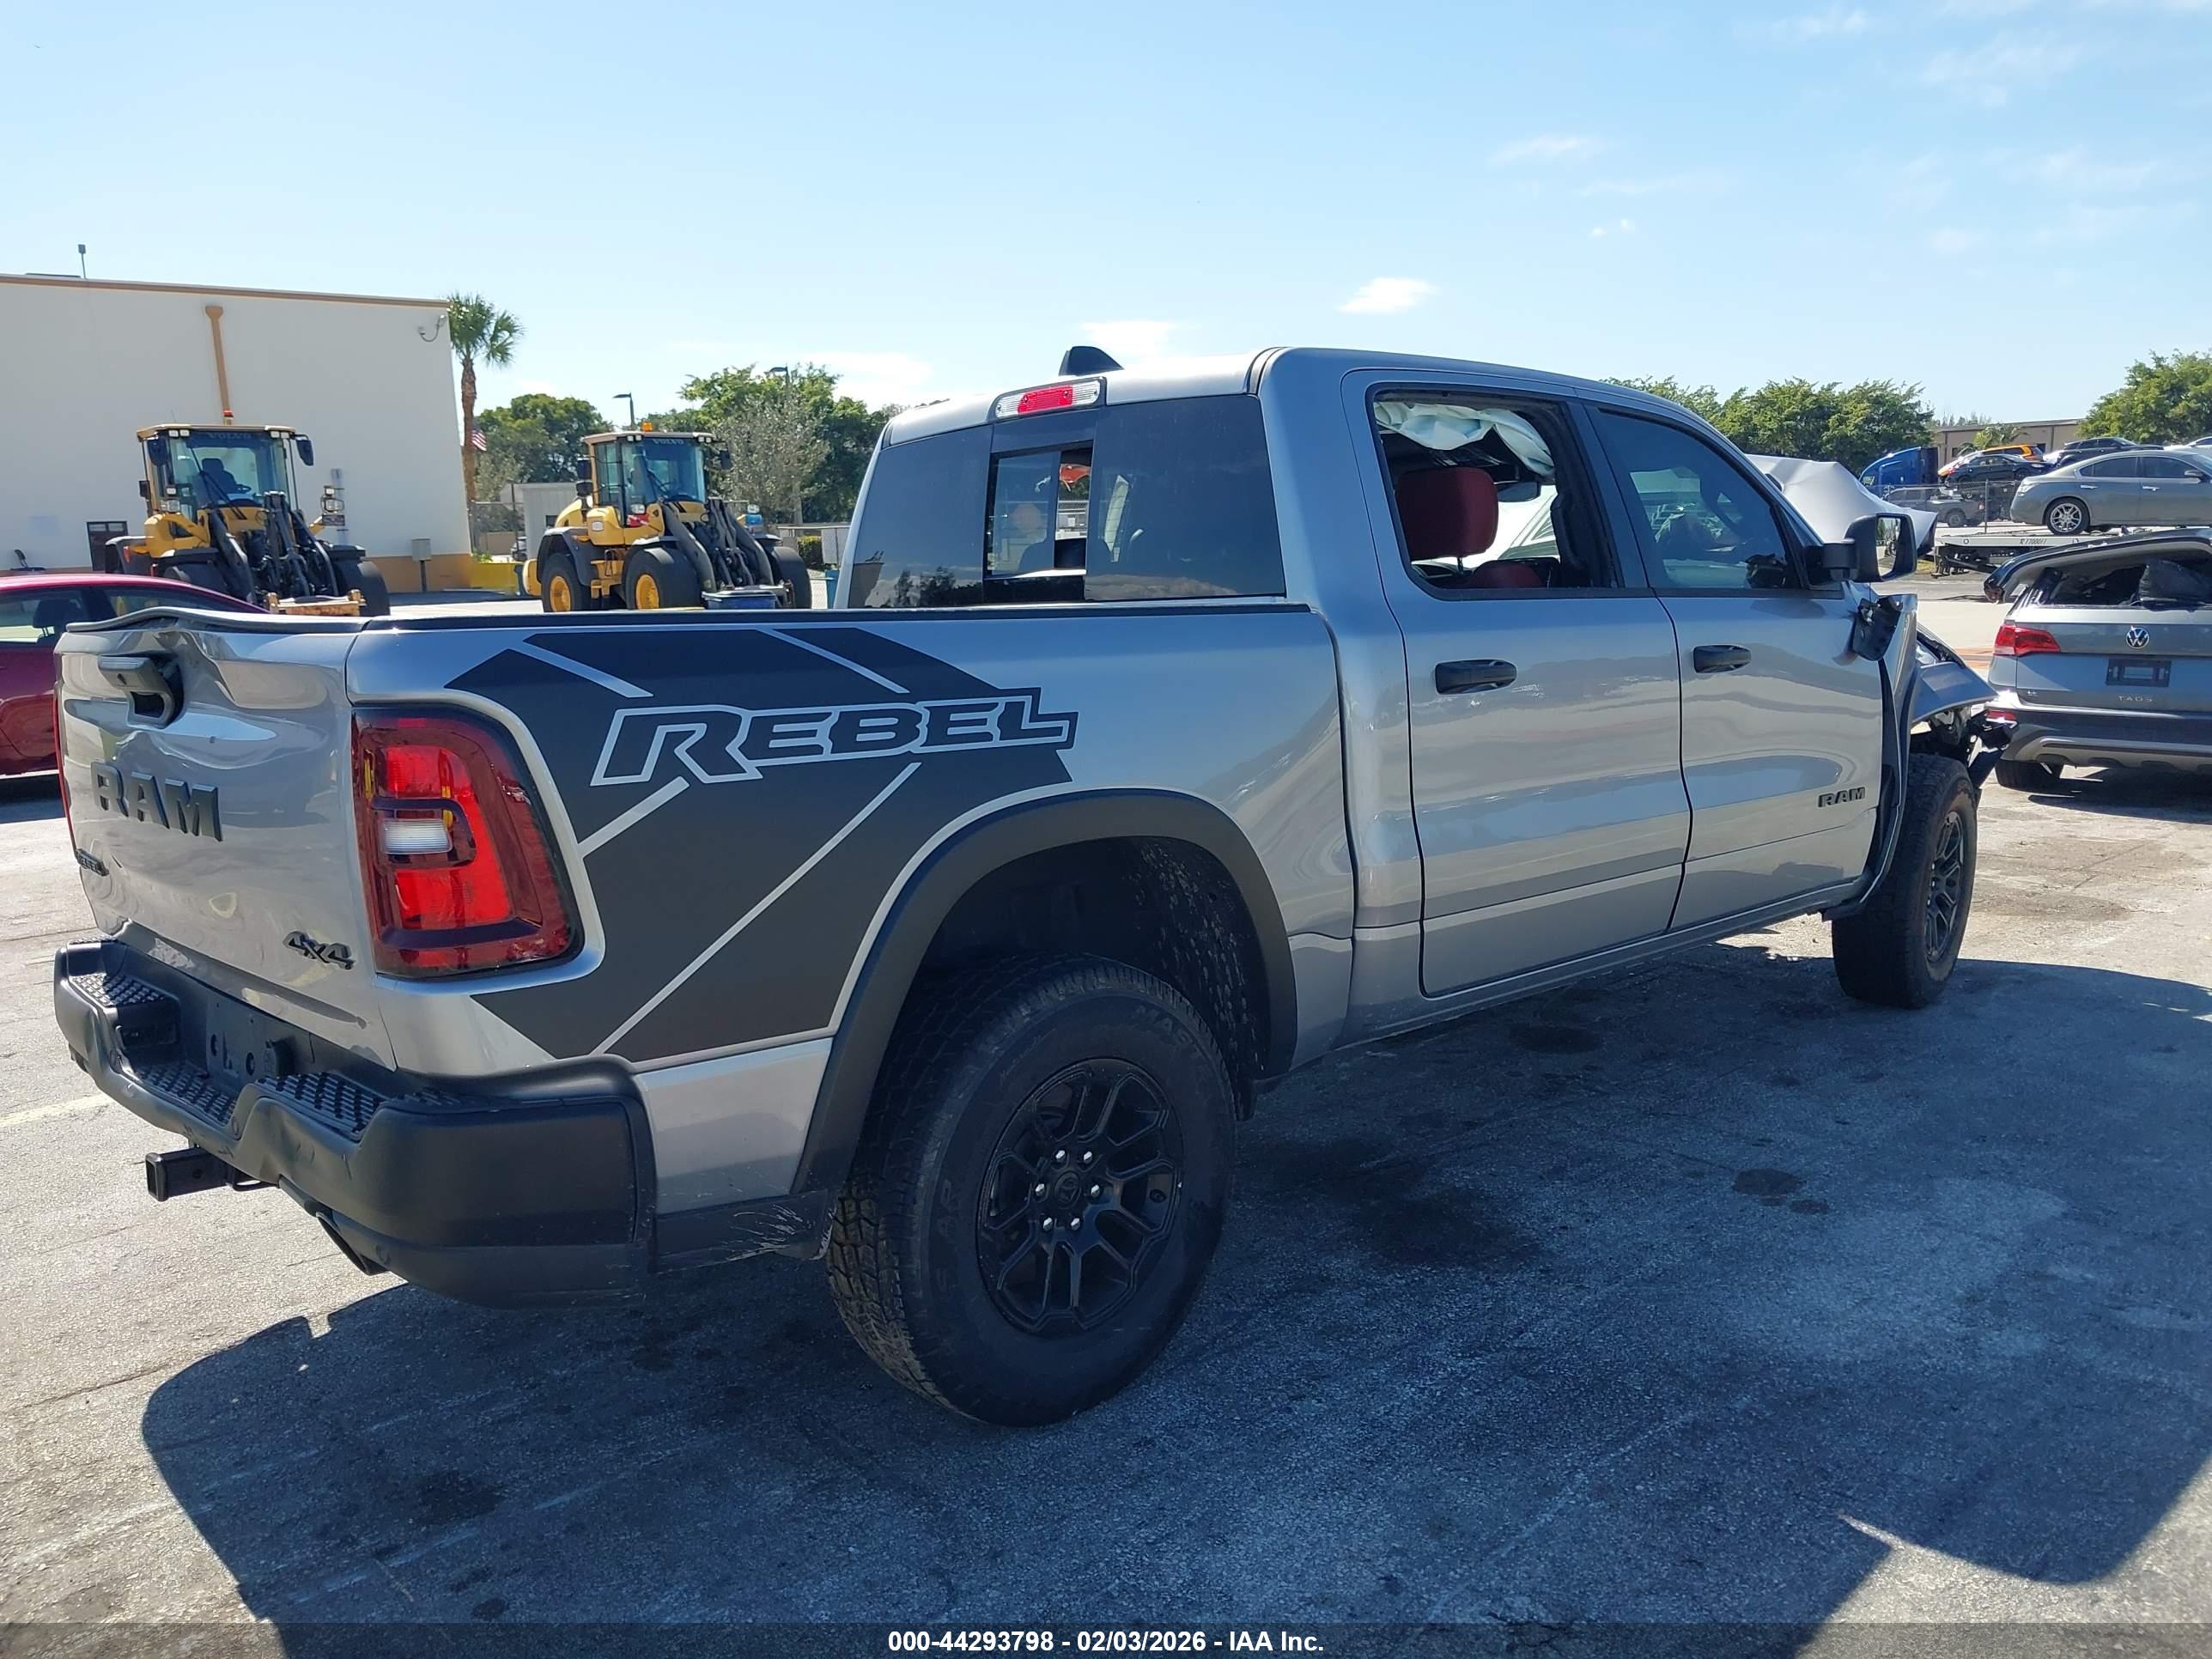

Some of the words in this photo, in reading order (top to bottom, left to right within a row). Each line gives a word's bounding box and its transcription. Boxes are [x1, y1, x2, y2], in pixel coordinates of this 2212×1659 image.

[590, 693, 1077, 786] REBEL
[91, 762, 223, 842] RAM
[1818, 787, 1866, 807] RAM
